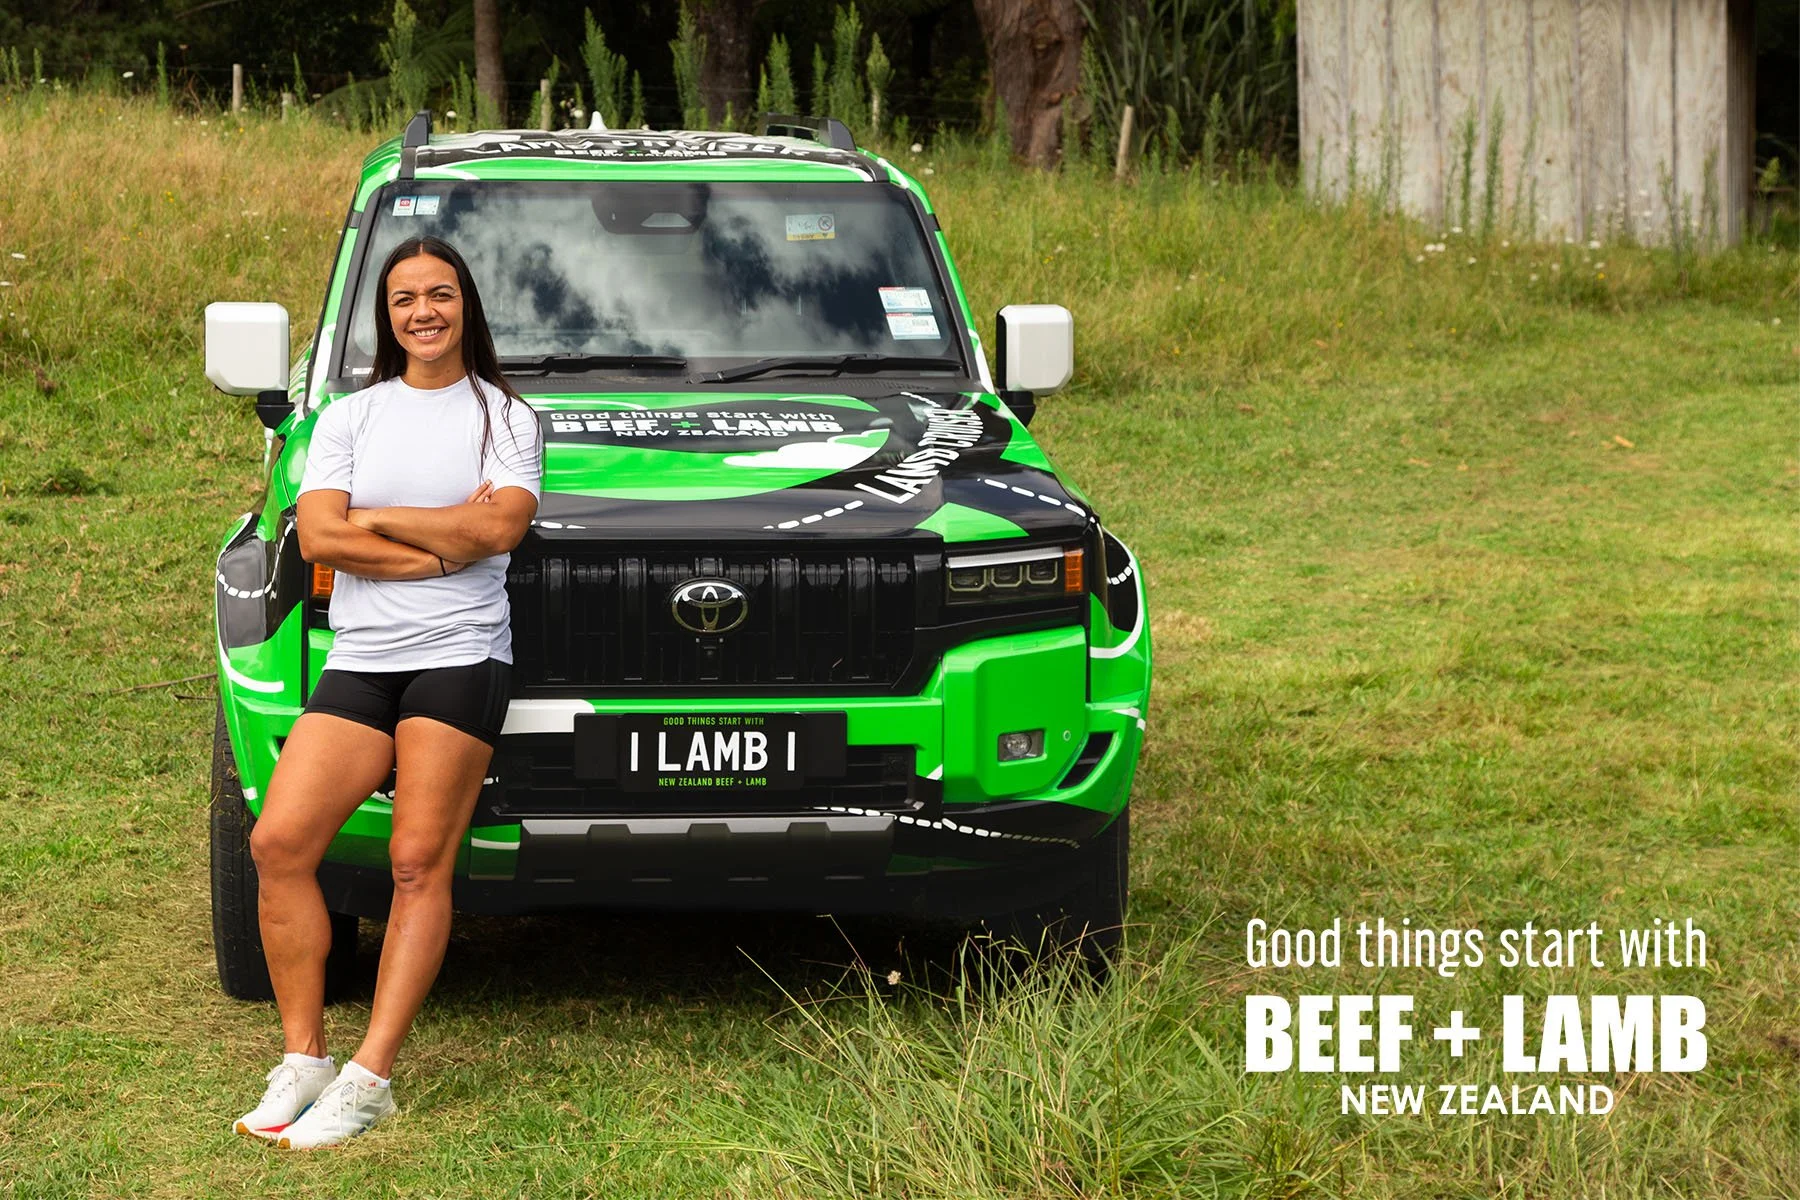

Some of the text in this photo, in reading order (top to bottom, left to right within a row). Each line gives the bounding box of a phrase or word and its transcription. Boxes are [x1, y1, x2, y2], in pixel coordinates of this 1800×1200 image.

[550, 410, 835, 420] Good things start with
[551, 420, 659, 433] BEEF
[711, 419, 844, 433] LAMB
[917, 407, 984, 447] CRUISER
[615, 429, 789, 437] NEW ZEALAND
[663, 717, 765, 726] GOOD THINGS START WITH
[657, 731, 768, 772] LAMB
[658, 777, 676, 787] NEW
[678, 777, 713, 787] ZEALAND
[715, 777, 735, 787] BEEF
[745, 777, 767, 787] LAMB
